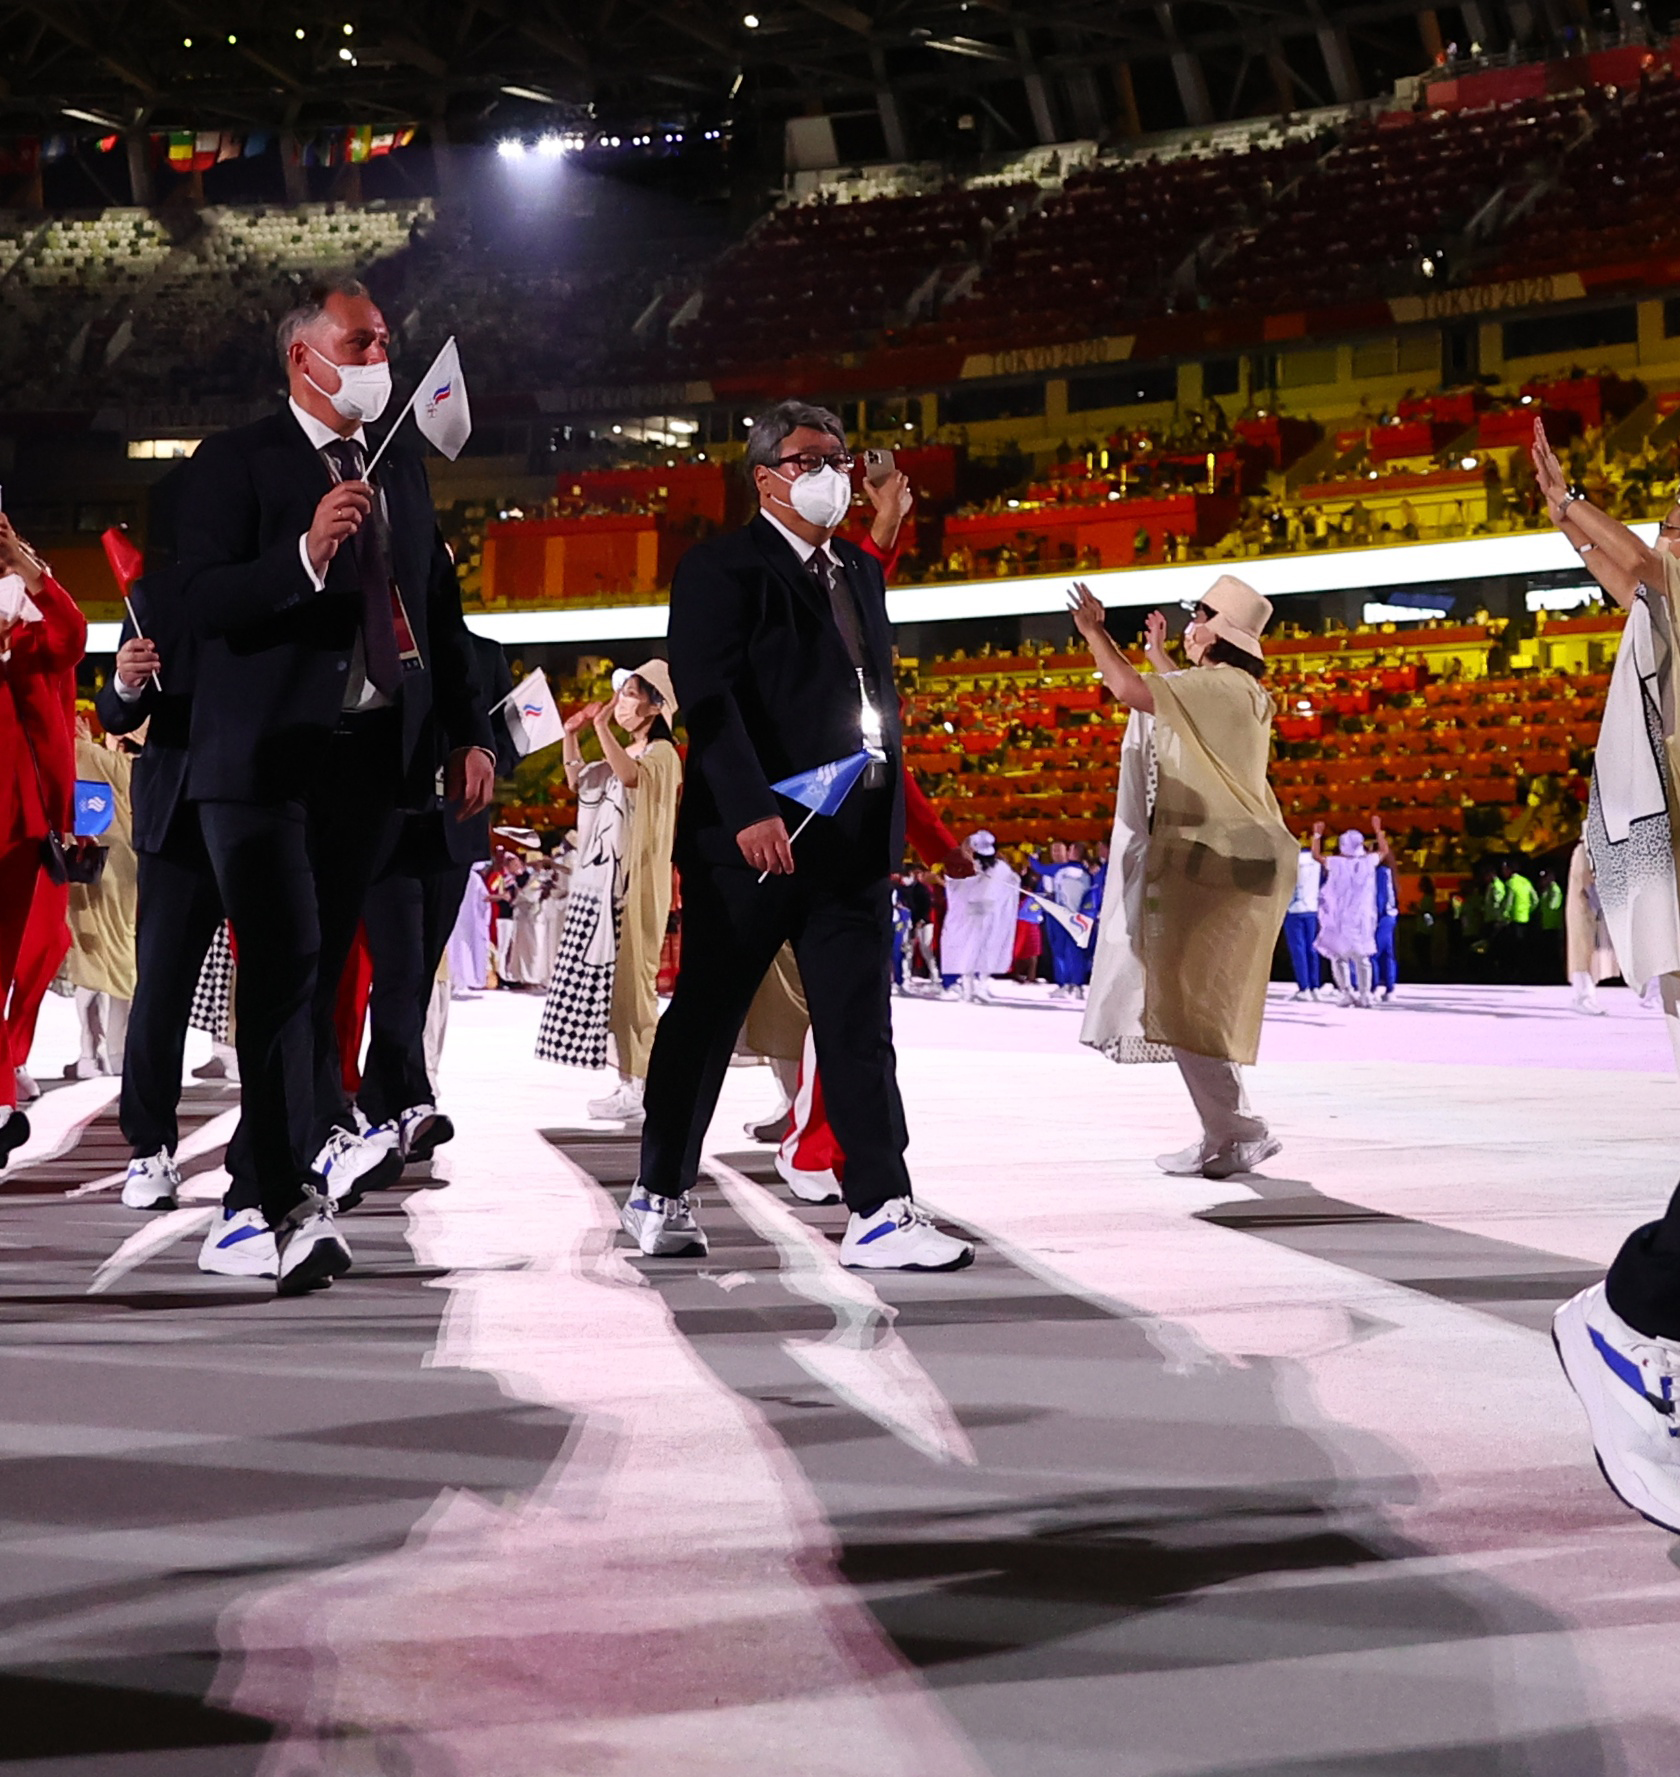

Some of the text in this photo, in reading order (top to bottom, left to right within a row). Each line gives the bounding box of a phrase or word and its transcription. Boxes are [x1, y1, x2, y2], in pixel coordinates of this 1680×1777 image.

[1422, 277, 1554, 320] TOKYO 2020
[991, 338, 1108, 375] TOKYO 2020
